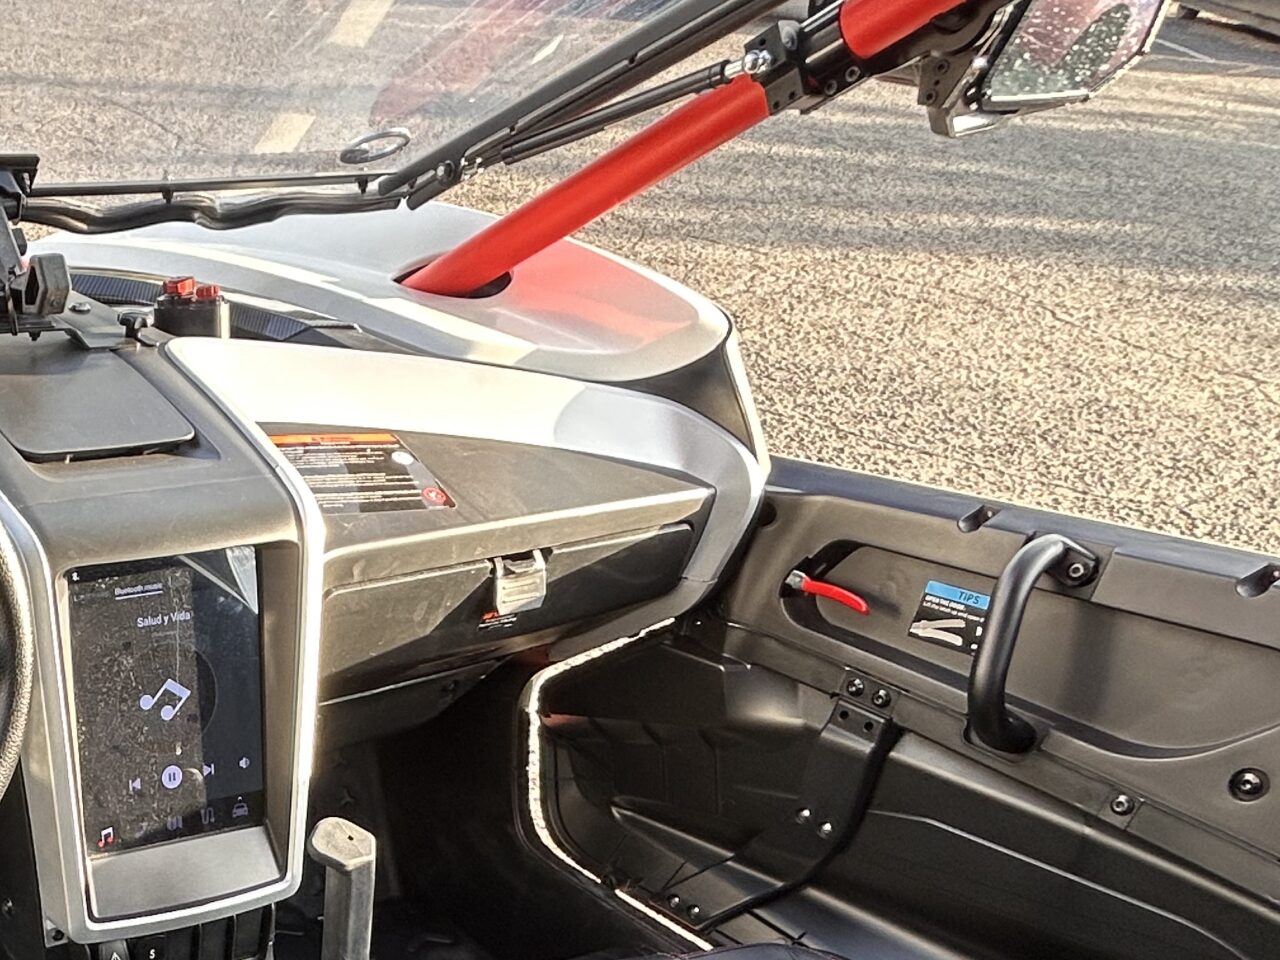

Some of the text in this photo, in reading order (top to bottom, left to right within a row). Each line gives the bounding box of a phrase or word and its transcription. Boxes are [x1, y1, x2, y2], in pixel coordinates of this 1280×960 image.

[137, 610, 191, 628] Salud y Vida
